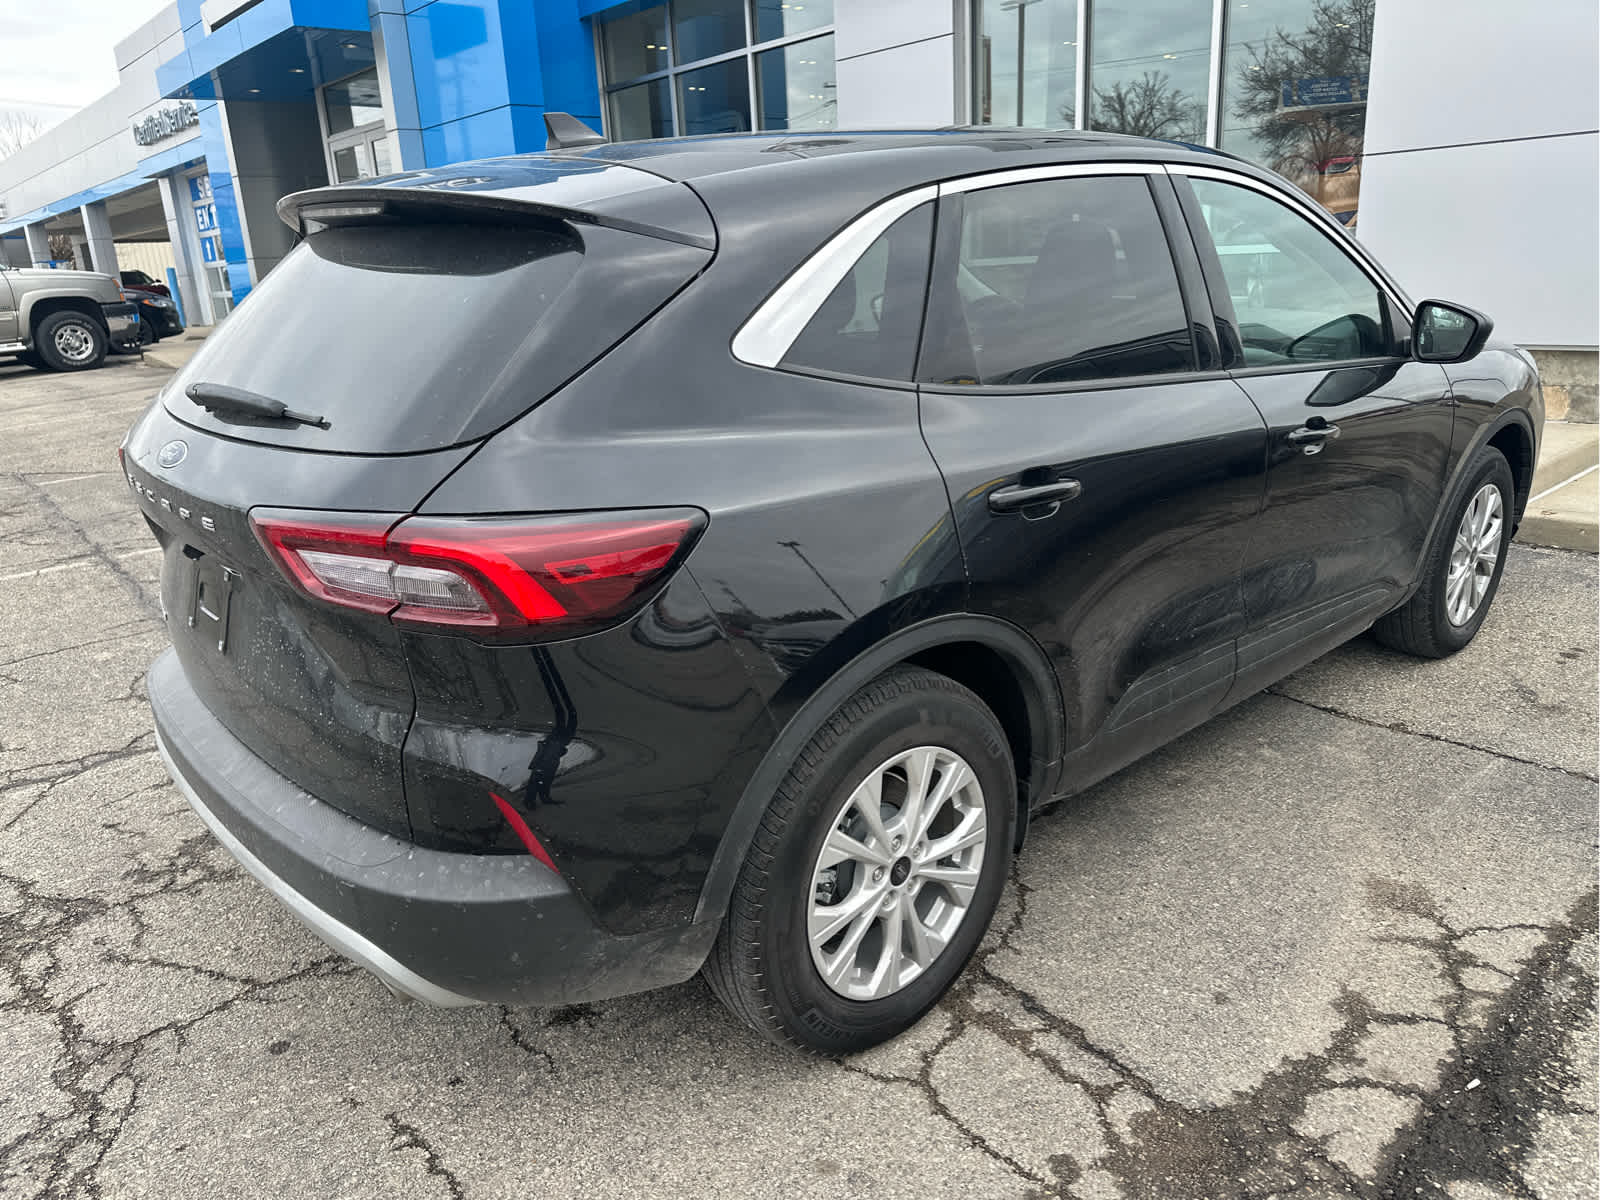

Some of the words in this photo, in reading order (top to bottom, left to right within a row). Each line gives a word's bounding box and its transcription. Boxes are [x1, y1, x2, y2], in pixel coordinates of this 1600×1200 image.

[133, 110, 164, 146] Certified
[163, 100, 198, 134] Service
[127, 473, 216, 532] ESCAPE
